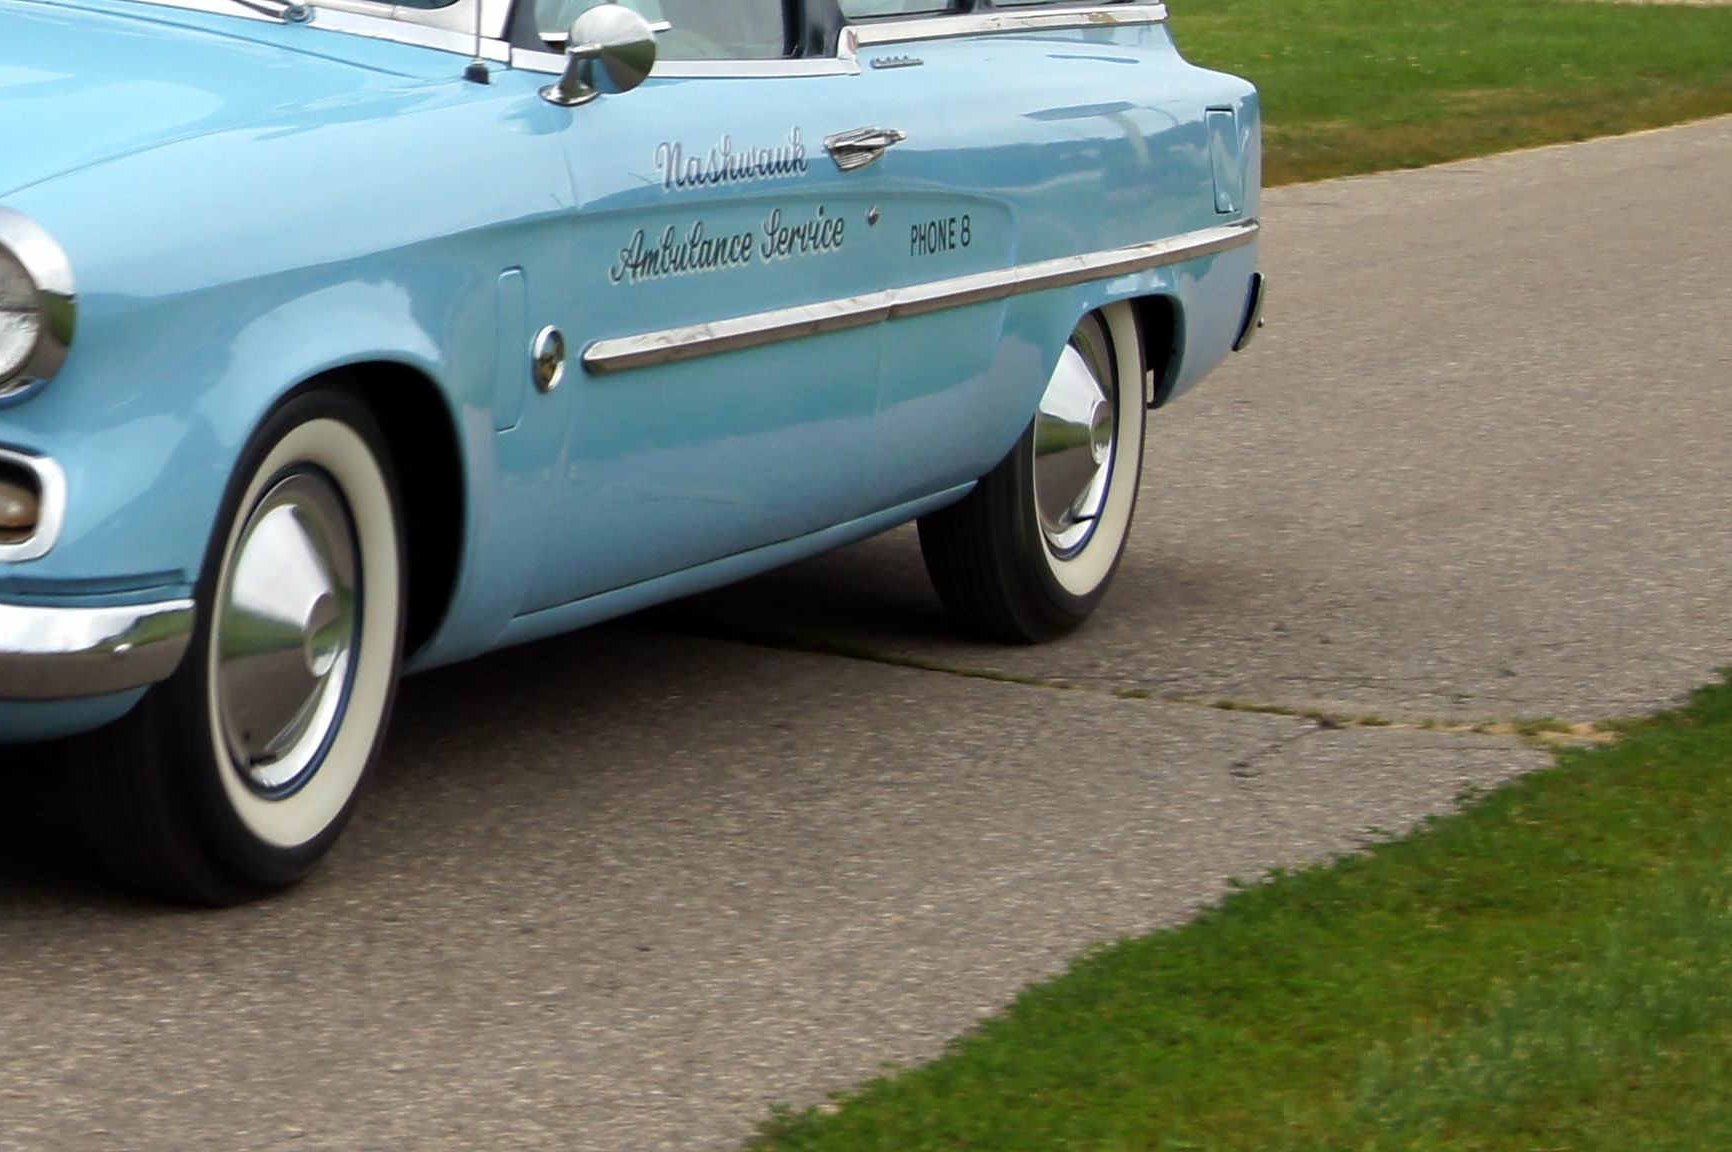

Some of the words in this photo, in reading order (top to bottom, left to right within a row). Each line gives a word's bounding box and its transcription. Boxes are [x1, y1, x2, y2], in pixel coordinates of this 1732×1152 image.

[654, 125, 808, 191] Nashwauk
[609, 218, 754, 285] Ambulance
[760, 205, 846, 261] Service
[909, 217, 956, 257] PHONE
[960, 213, 972, 248] 8
